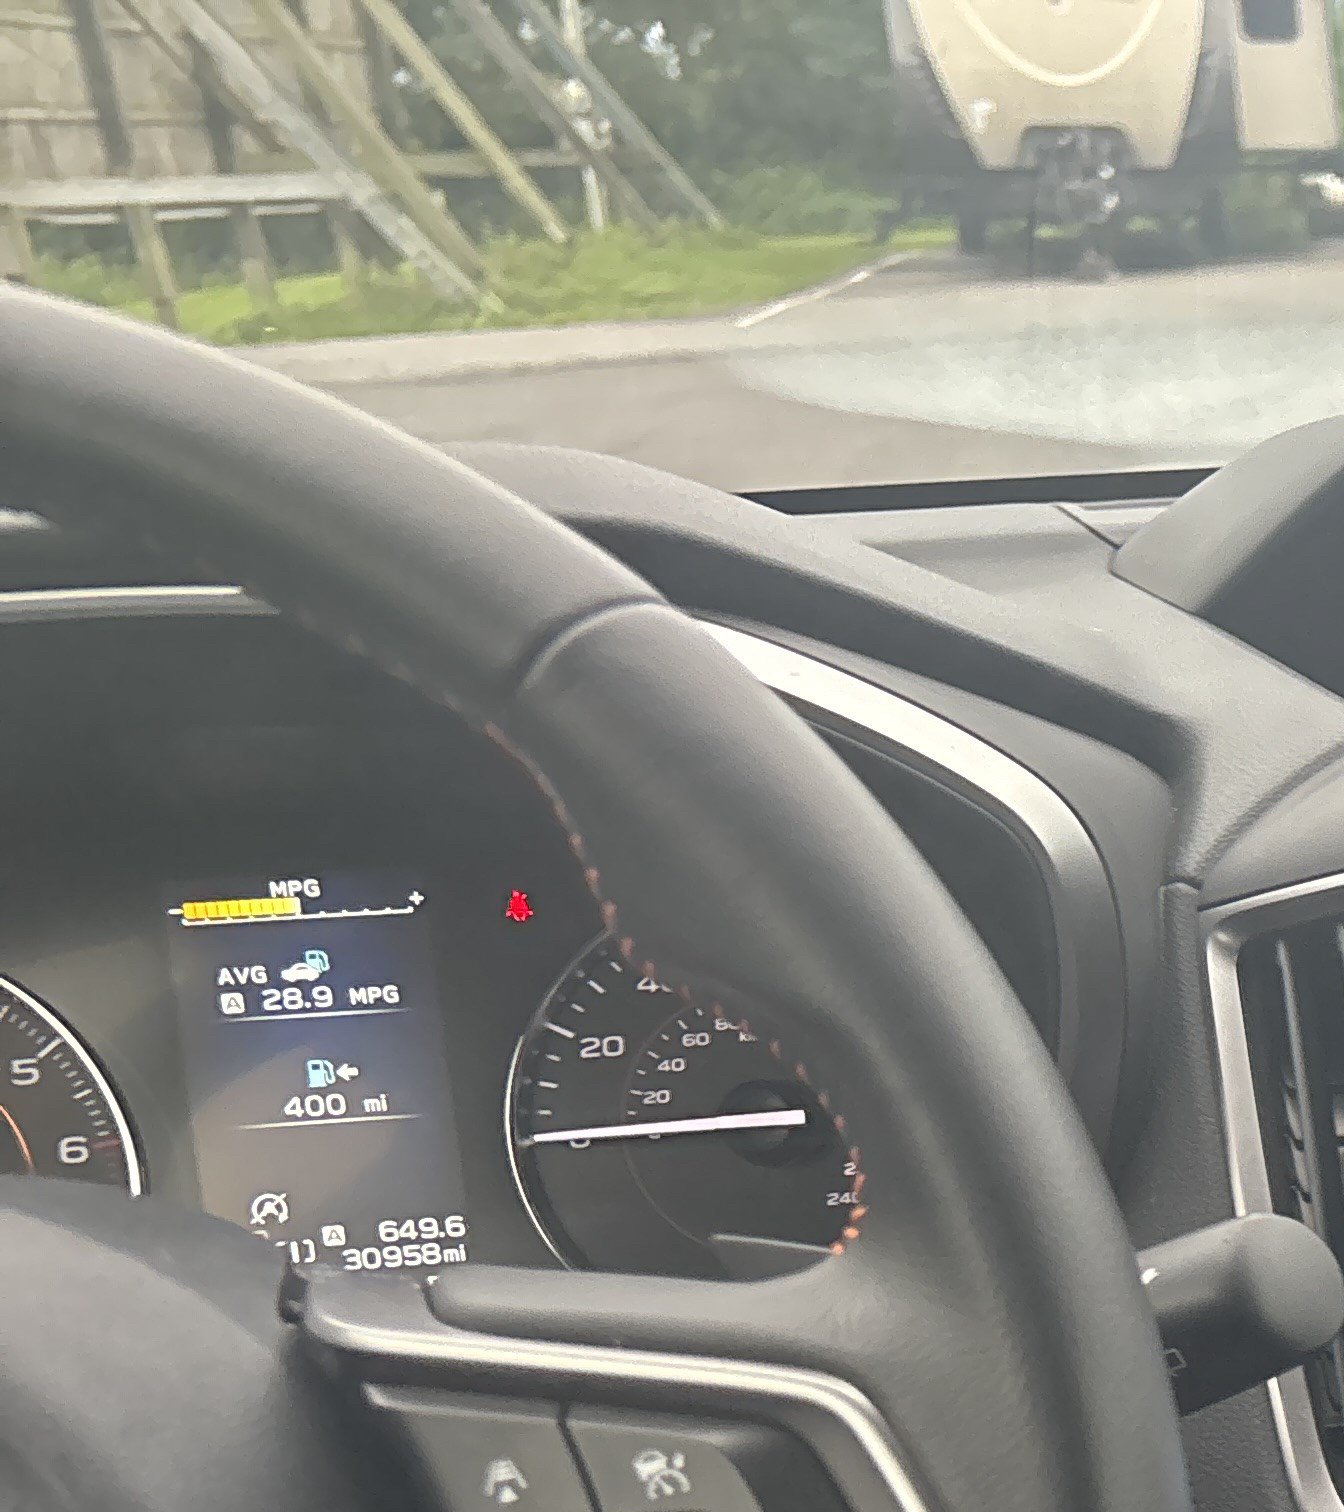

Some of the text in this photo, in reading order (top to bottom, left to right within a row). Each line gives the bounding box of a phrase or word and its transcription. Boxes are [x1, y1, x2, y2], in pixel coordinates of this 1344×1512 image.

[269, 878, 322, 899] MPG
[217, 965, 269, 986] AVG
[261, 985, 334, 1011] 28.9
[348, 984, 400, 1006] MPG
[579, 1035, 625, 1060] 20
[680, 1032, 711, 1048] 60
[10, 1057, 42, 1087] 5
[657, 1057, 687, 1073] 40
[284, 1092, 389, 1118] 400 mi
[641, 1089, 672, 1105] 20
[59, 1135, 90, 1164] 6
[378, 1214, 467, 1243] 649.6
